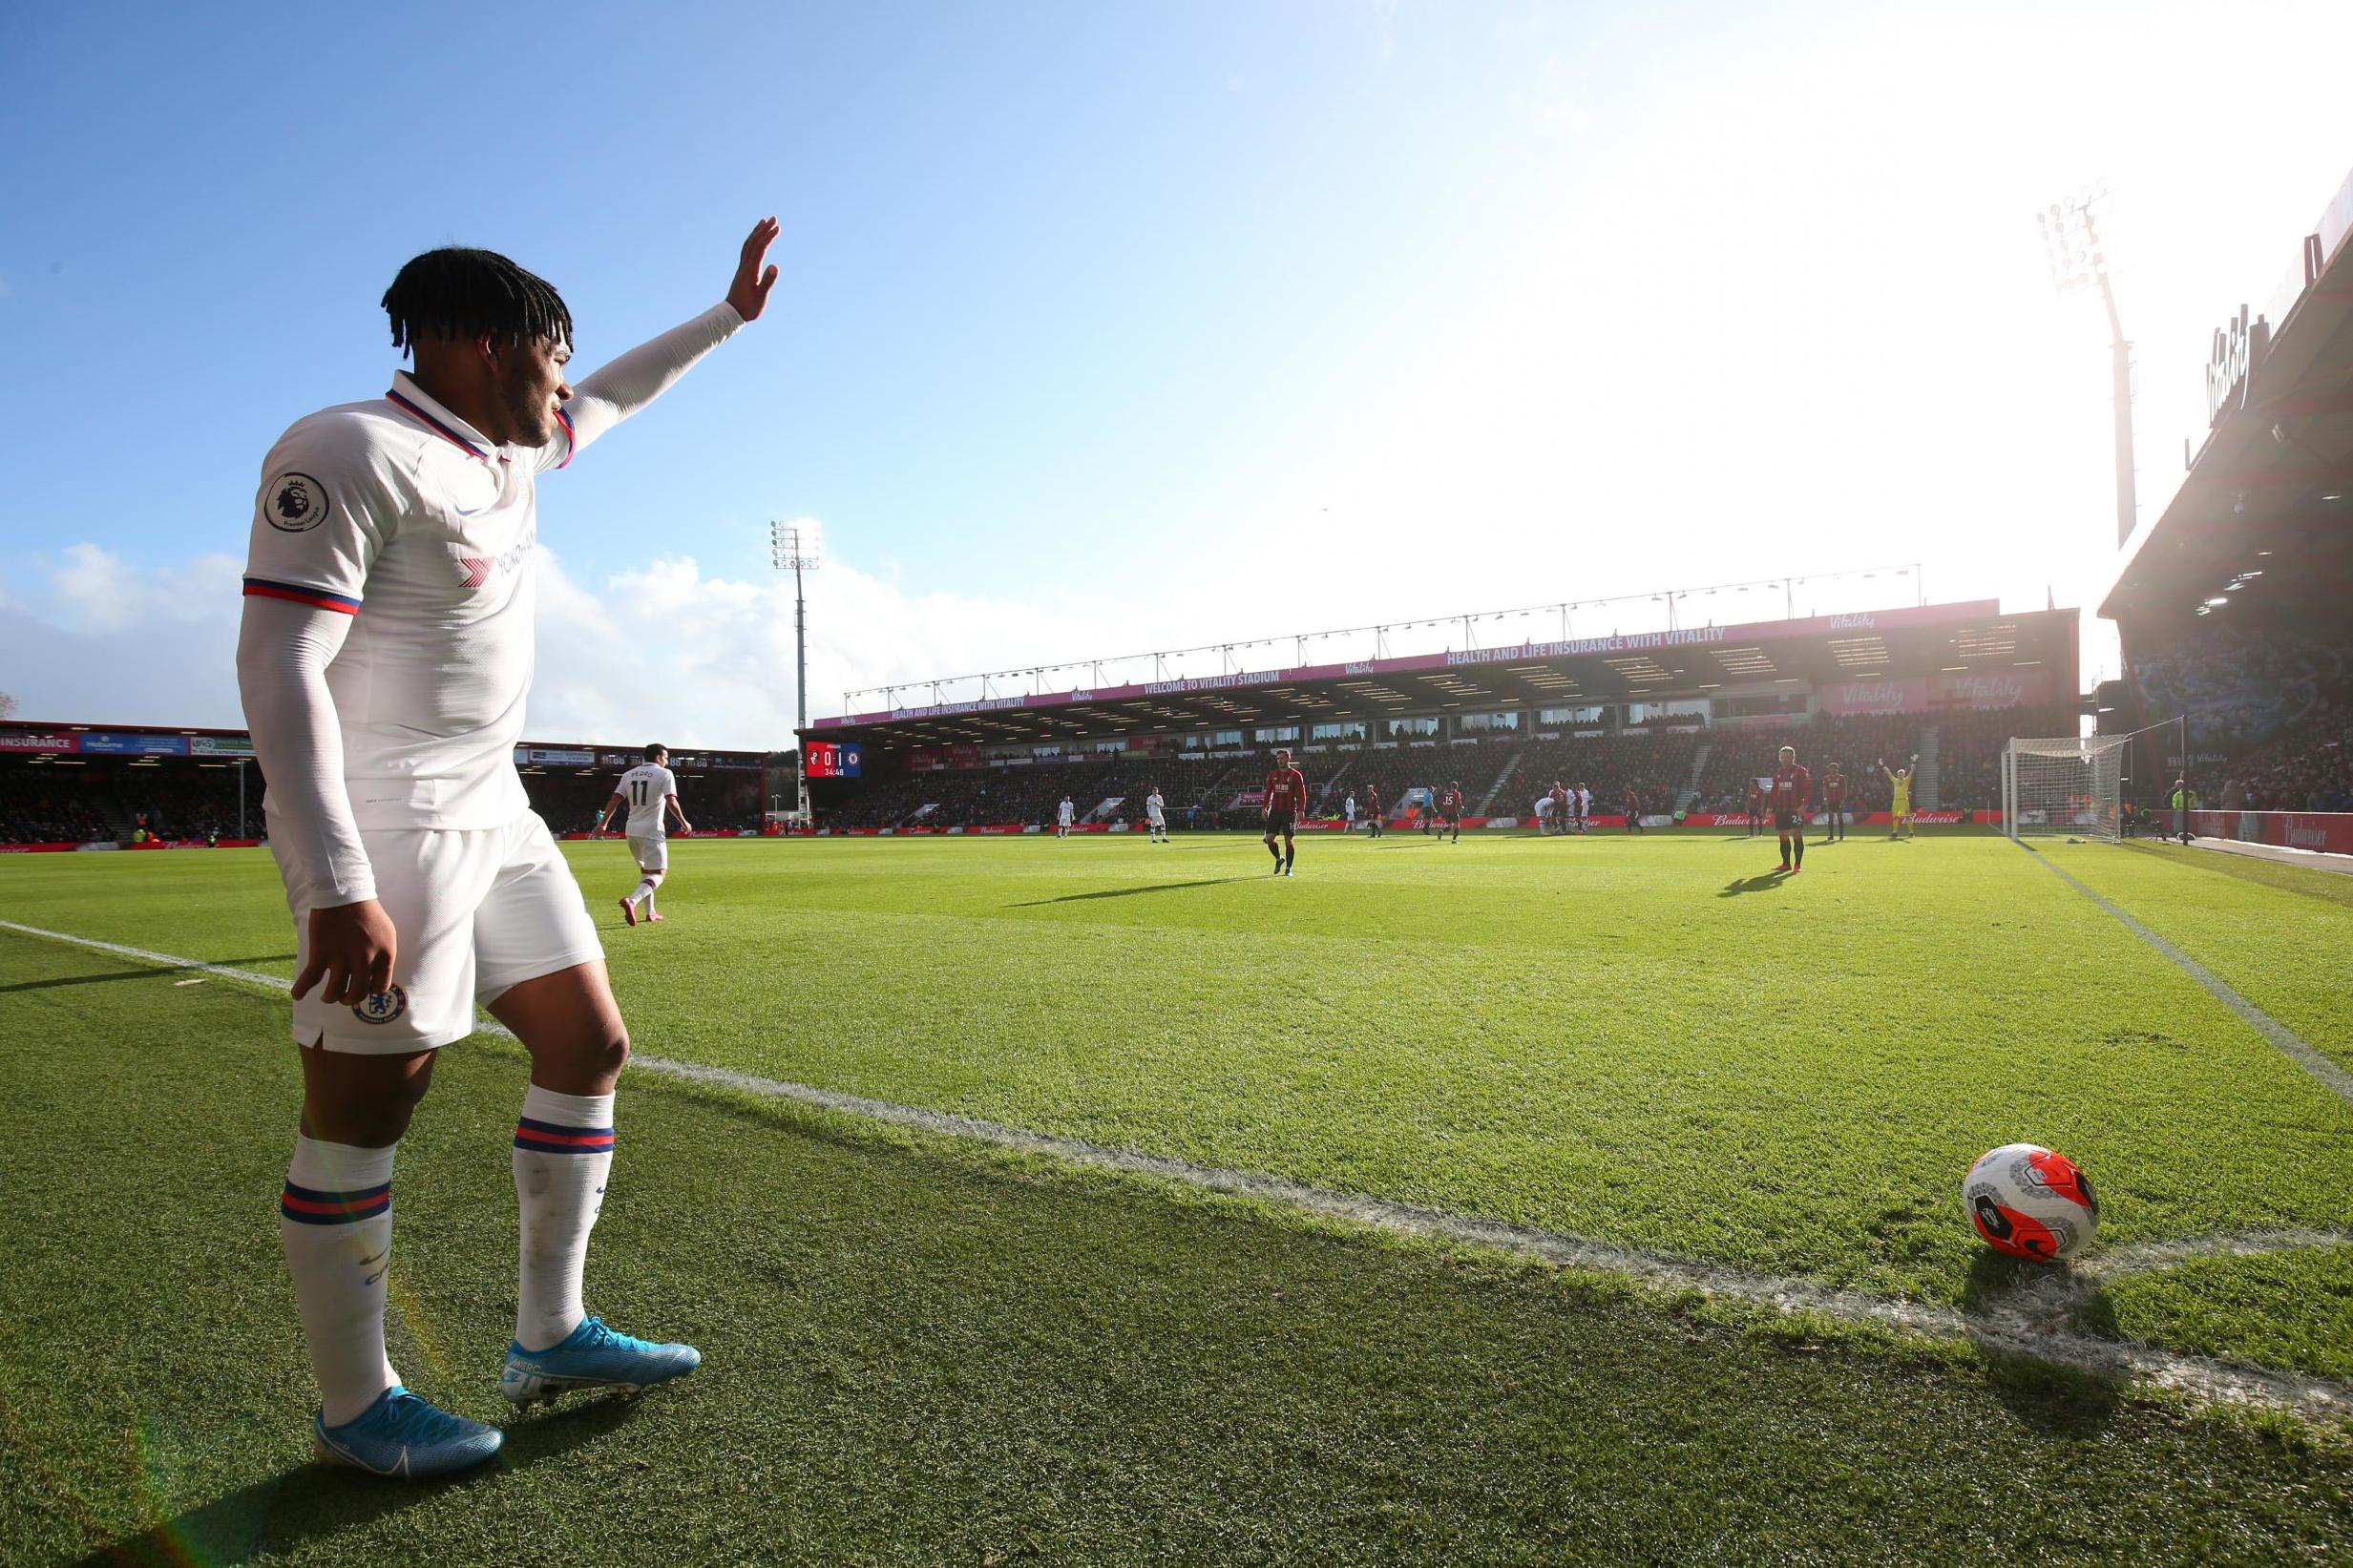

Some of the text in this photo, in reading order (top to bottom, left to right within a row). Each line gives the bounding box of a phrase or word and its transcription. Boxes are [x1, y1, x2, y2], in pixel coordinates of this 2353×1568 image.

[1829, 613, 1875, 628] Vitality
[1447, 627, 1726, 665] HEALTH AND LIFE INSURANCE WITH VITALITY
[1345, 662, 1374, 675] Vitality
[1145, 671, 1279, 695] WELCOME TO VITALITY STADIUM
[1955, 675, 2023, 698] Vitality
[1842, 685, 1903, 704] Vitality
[892, 698, 1024, 720] HEALTH AND LIFE INSURANCE WITH VITALITY
[0, 738, 71, 748] INSURANCE
[824, 751, 831, 766] 0
[631, 769, 654, 779] PEDRO
[631, 780, 649, 806] 11
[2282, 814, 2327, 847] Budweiser
